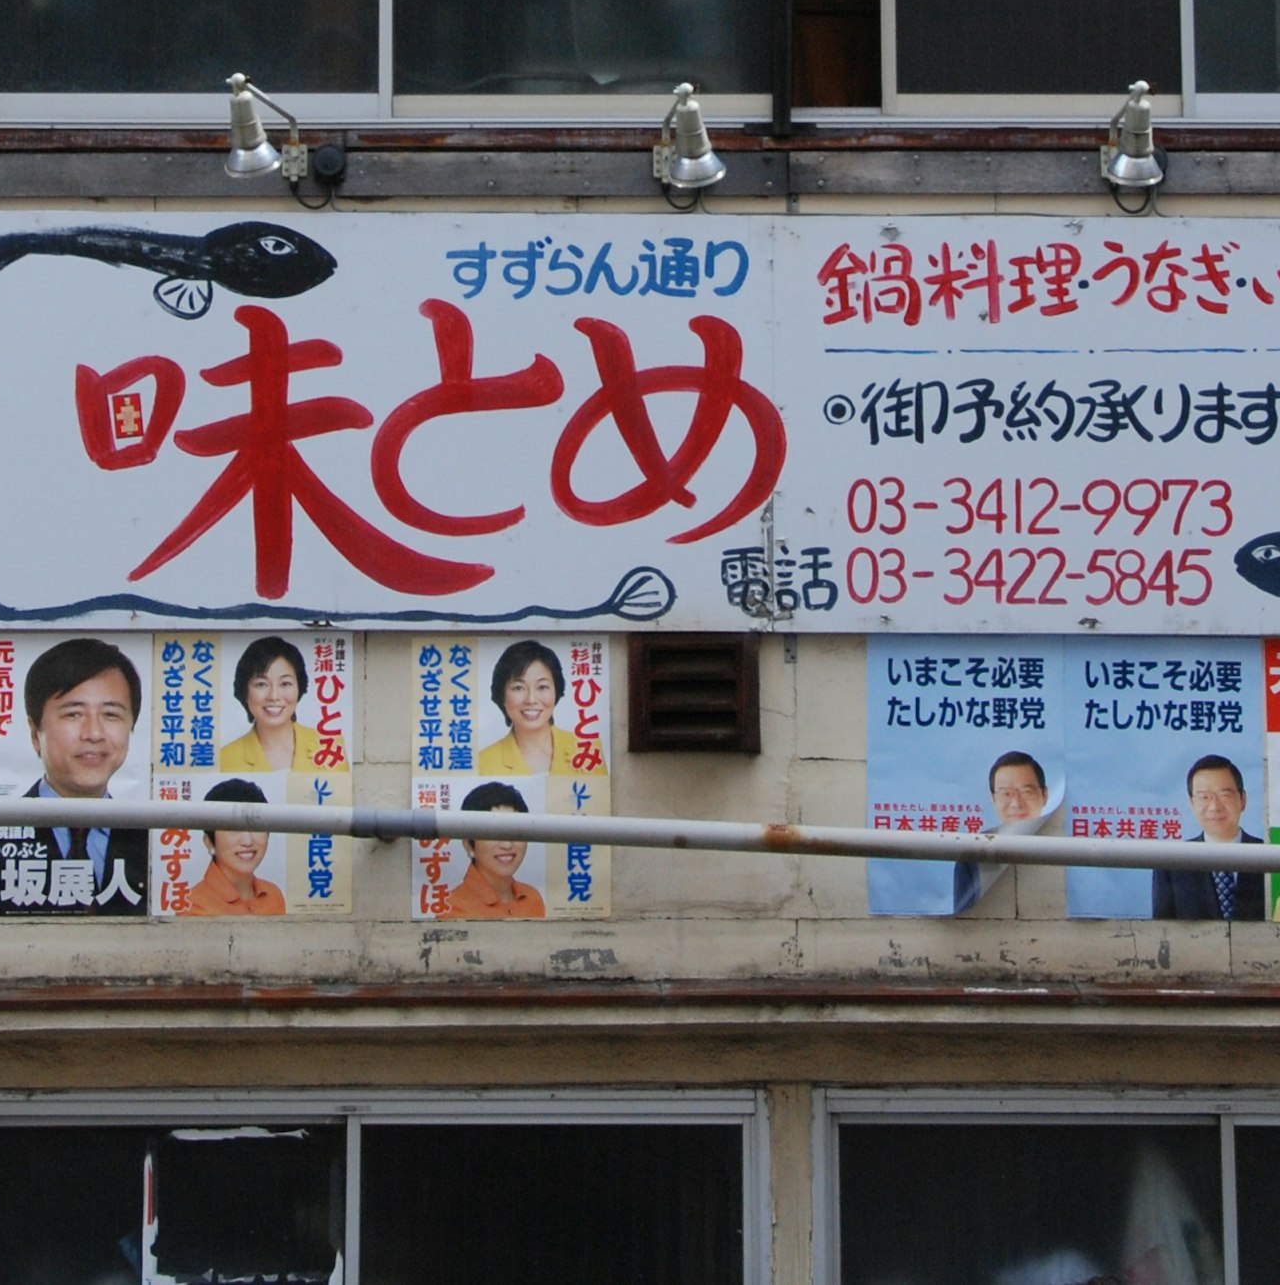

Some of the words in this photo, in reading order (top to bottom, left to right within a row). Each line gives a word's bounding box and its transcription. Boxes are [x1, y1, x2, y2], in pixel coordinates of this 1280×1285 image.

[447, 237, 750, 300] すずらん通り
[75, 297, 787, 599] 味とめ
[847, 477, 1234, 537] 03-3412-9973
[721, 546, 838, 617] 電話
[846, 546, 1213, 607] 03-3422-5845
[335, 638, 345, 672] 弁護士
[592, 642, 602, 676] 弁護士
[887, 657, 1045, 689] いまこそ必要
[1085, 660, 1242, 693] いまこそ必要
[160, 640, 186, 767] めざせ平和
[190, 640, 215, 767] なくせ格差
[314, 645, 345, 768] 杉浦ひとみ
[418, 644, 443, 770] めざせ平和
[448, 644, 473, 770] なくせ格差
[571, 648, 602, 771] 杉浦ひとみ
[886, 696, 1046, 729] たしかな野党
[1085, 699, 1243, 733] たしかな野党
[1072, 818, 1182, 840] 日本共産党
